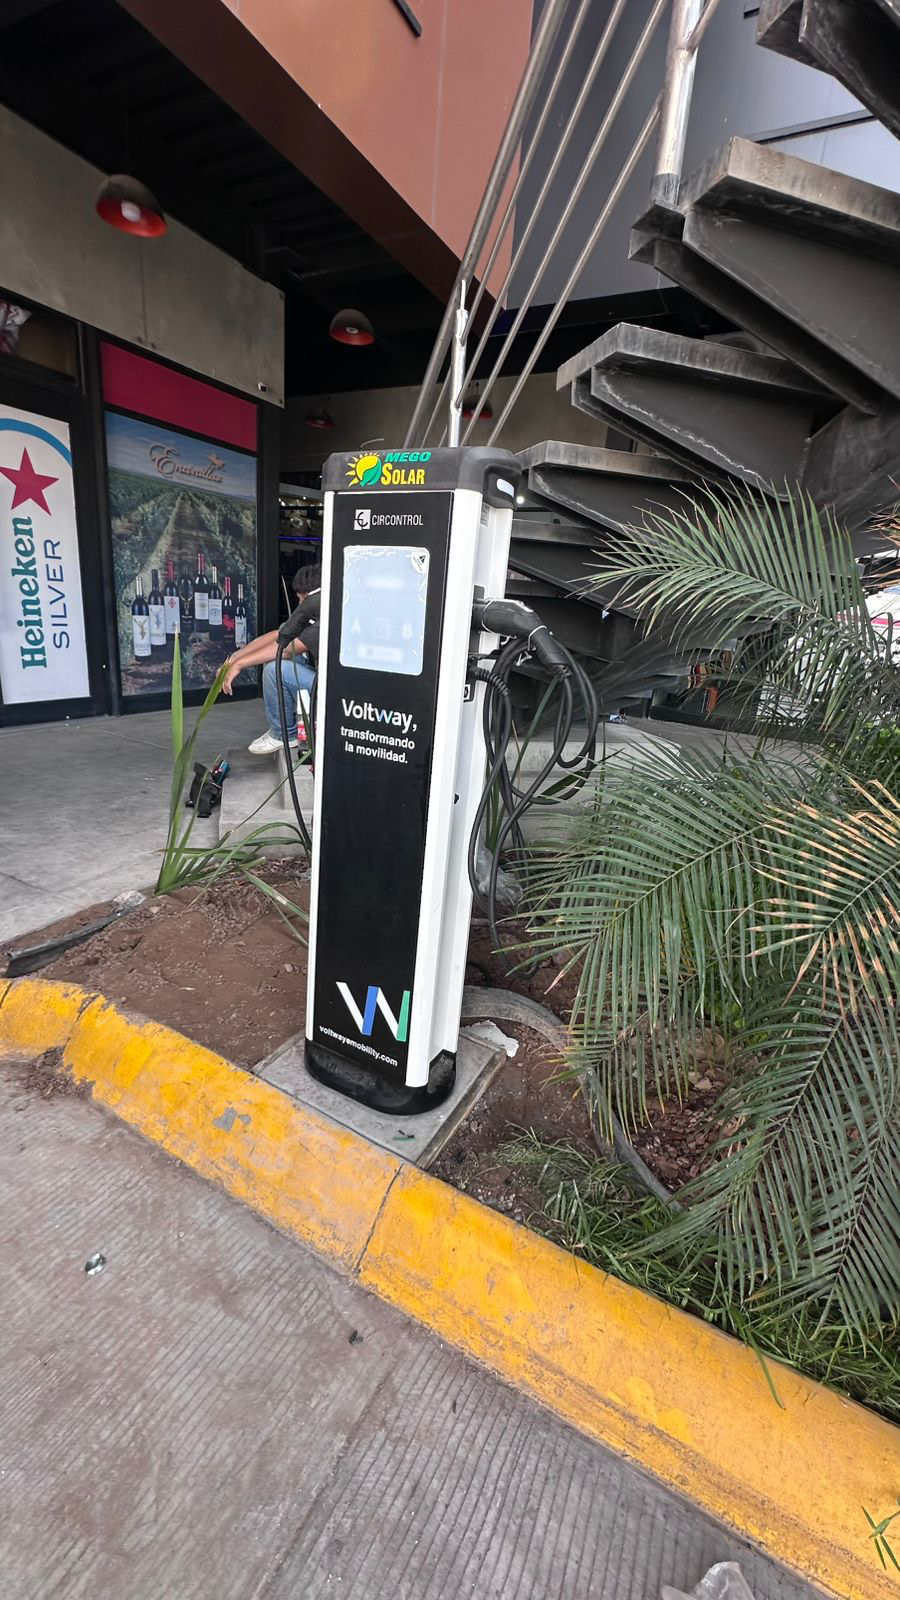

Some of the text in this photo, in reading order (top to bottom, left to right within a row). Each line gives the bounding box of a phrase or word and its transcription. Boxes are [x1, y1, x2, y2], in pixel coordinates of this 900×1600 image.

[384, 451, 432, 462] MEGO
[380, 462, 426, 486] SOLAR
[371, 514, 424, 526] CIRCONTROL
[11, 516, 48, 669] Heineken
[43, 539, 70, 649] SILVER
[341, 698, 417, 734] Voltway,
[340, 725, 416, 750] transformando
[344, 740, 409, 764] la movilidad.
[319, 1025, 399, 1067] voltwayemobility.com
